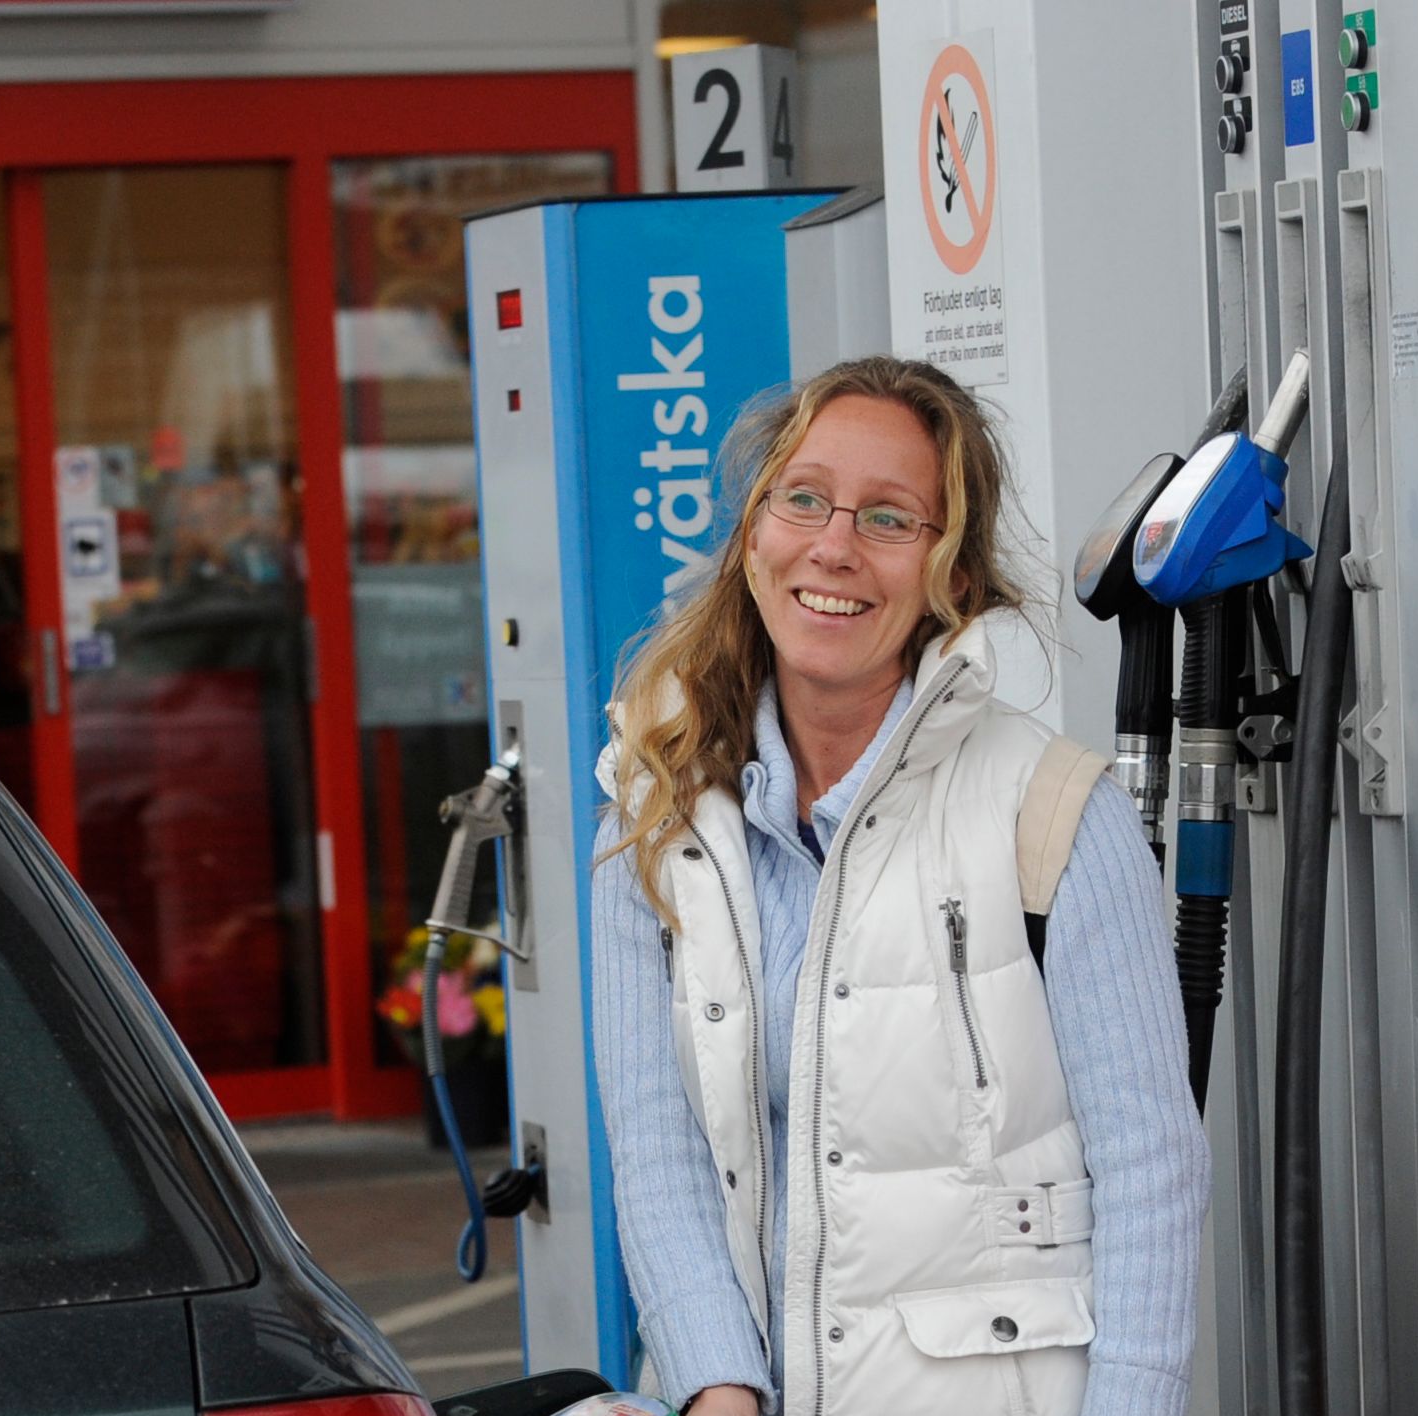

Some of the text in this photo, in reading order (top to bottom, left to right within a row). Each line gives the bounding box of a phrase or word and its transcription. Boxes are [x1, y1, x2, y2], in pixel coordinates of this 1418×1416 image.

[1221, 4, 1247, 25] DIESEL
[692, 67, 745, 172] 2
[1290, 77, 1305, 96] E85
[771, 76, 794, 177] 4
[924, 289, 962, 316] Förbjudet
[989, 284, 1002, 310] lag
[617, 274, 717, 614] vätska
